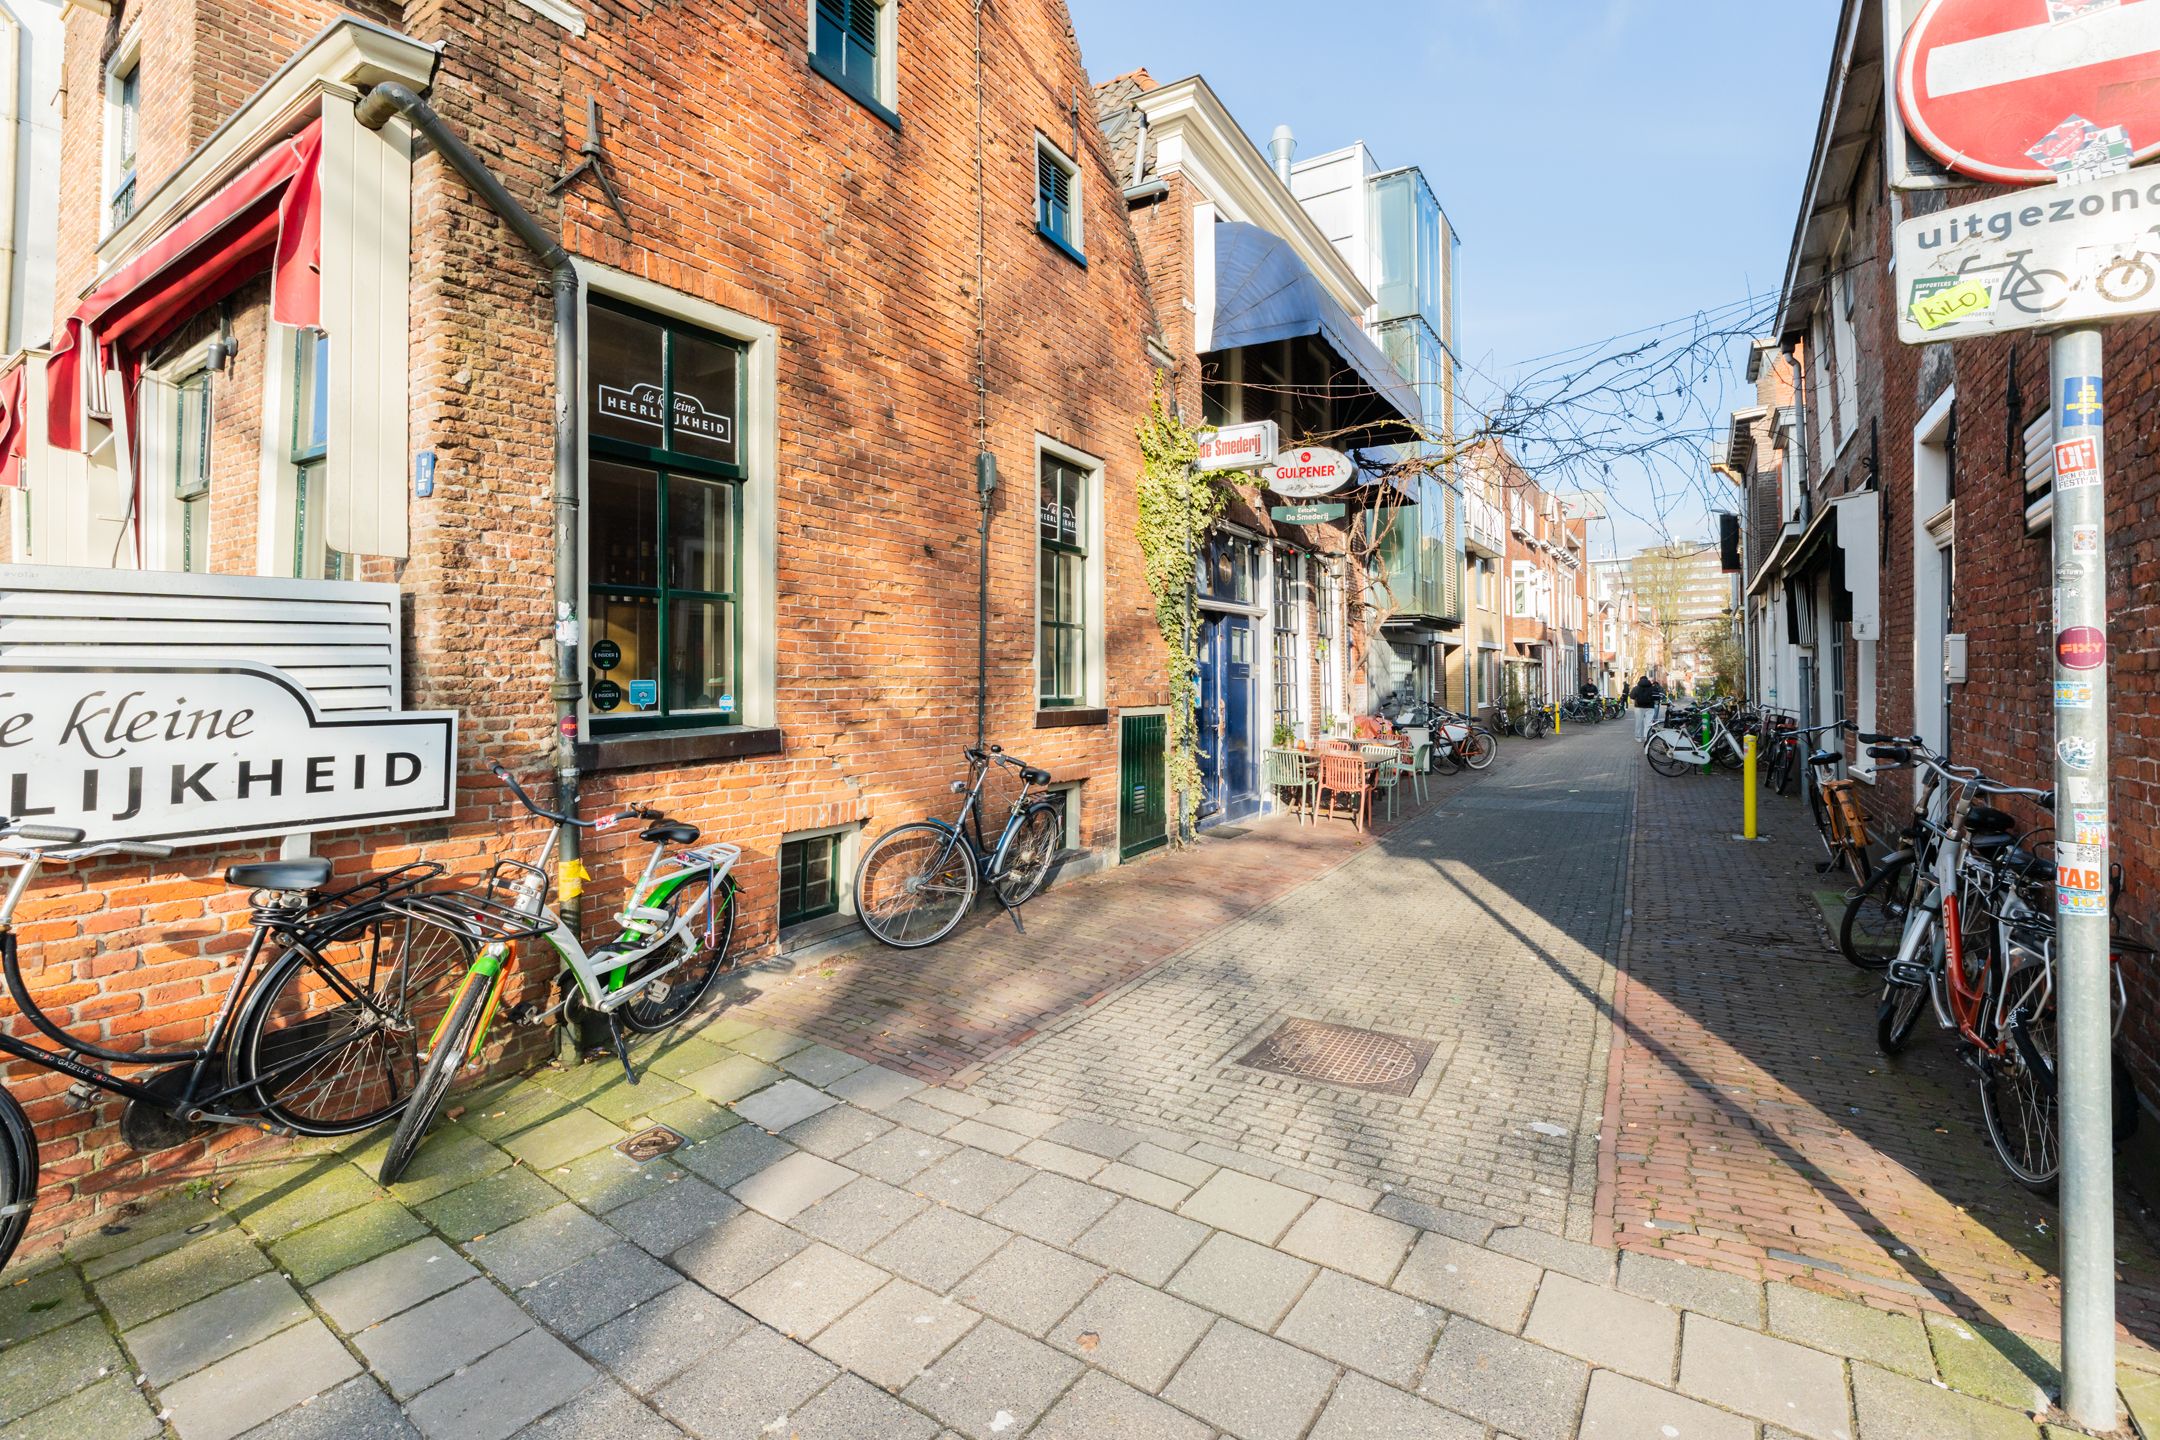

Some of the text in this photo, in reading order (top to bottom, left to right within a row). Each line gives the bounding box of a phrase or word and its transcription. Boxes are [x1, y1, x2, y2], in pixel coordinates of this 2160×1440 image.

[1915, 281, 1951, 289] SUPPORTERS
[642, 391, 655, 403] de
[607, 396, 724, 434] HEERLIJKHEID
[1199, 434, 1261, 458] de Smederij
[1276, 464, 1336, 479] GULPENER
[2058, 470, 2097, 482] OPEN FLAIR
[2058, 476, 2099, 489] FESTIVAL
[1297, 512, 1329, 521] Smederij
[2060, 643, 2102, 655] FIXY
[59, 690, 254, 759] kleine
[2057, 866, 2100, 890] TAB
[1943, 904, 1953, 969] Gazelle
[57, 1058, 91, 1075] GAZELLE
